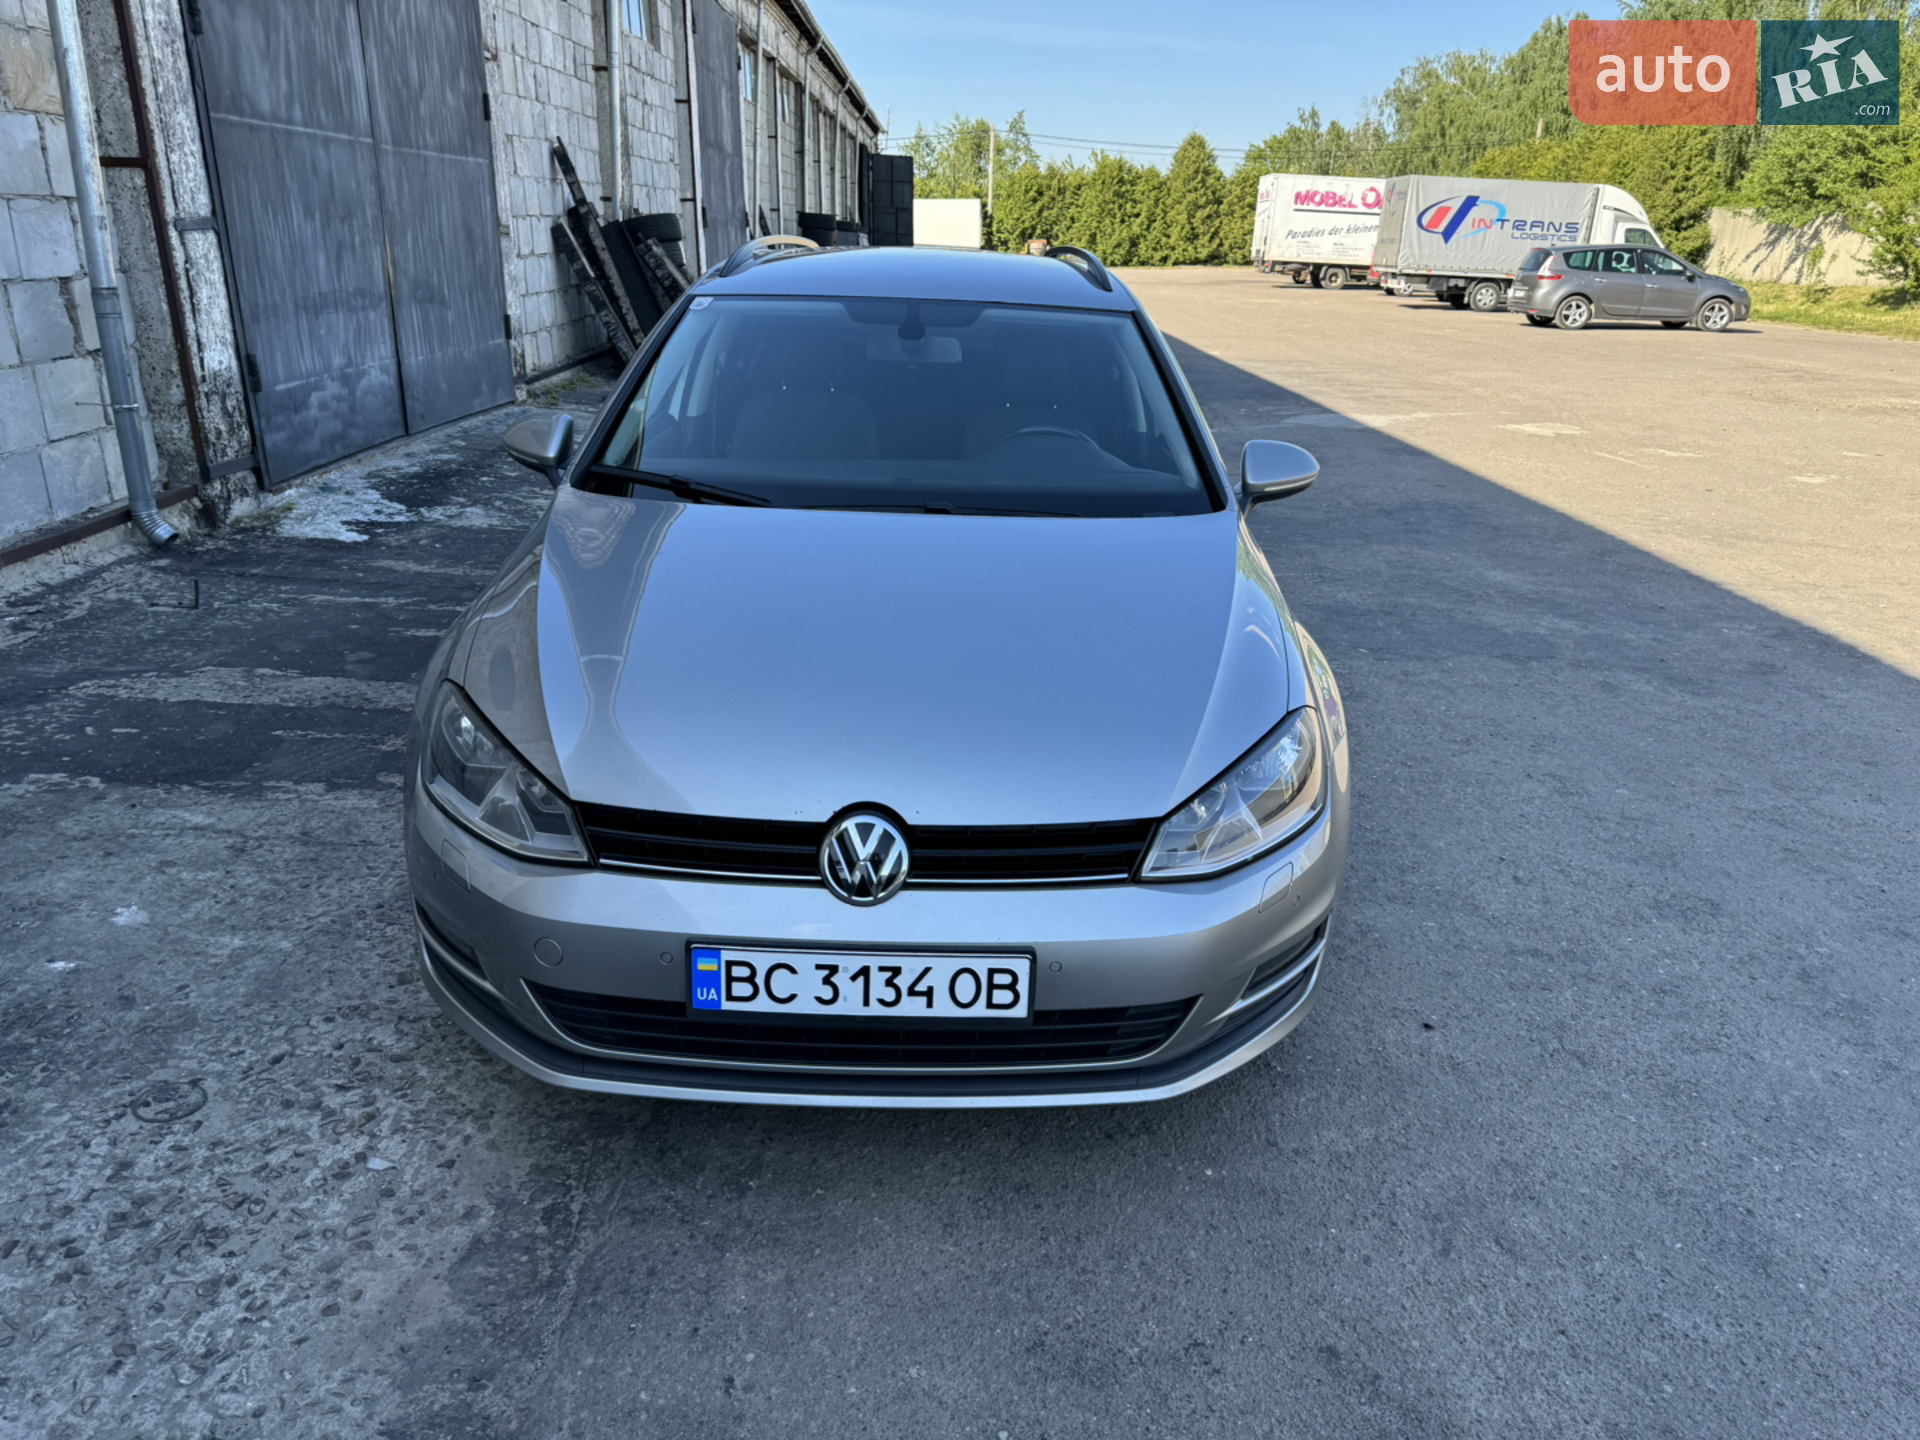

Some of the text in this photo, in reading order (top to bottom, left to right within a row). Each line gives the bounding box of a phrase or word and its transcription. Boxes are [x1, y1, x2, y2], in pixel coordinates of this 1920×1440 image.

[1285, 227, 1326, 240] Paradies
[1327, 225, 1344, 236] der
[1511, 232, 1578, 242] LOGISTICS
[724, 959, 1021, 1010] BC 3134 OB
[697, 987, 718, 1001] UA
